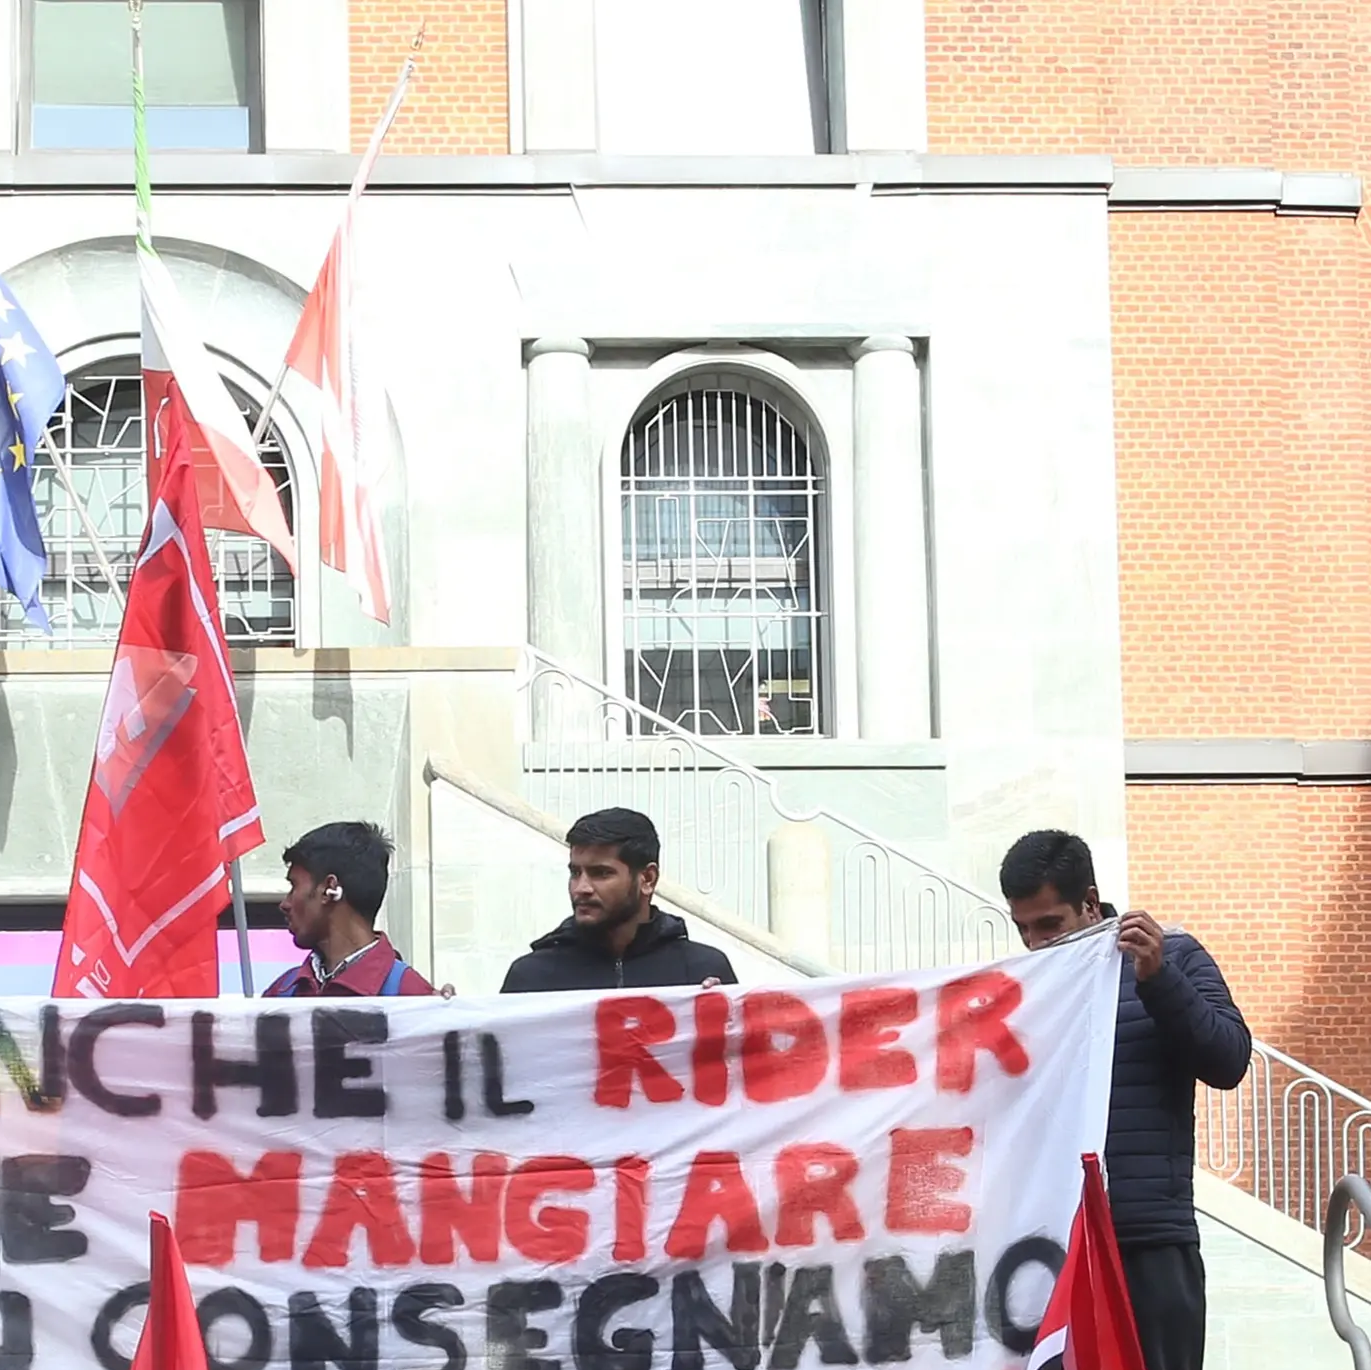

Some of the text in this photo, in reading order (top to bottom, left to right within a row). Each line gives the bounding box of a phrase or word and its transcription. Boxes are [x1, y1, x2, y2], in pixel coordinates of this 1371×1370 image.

[443, 1029, 535, 1121] IL
[594, 970, 1030, 1108] RIDER
[176, 1127, 974, 1268] MANGIARE
